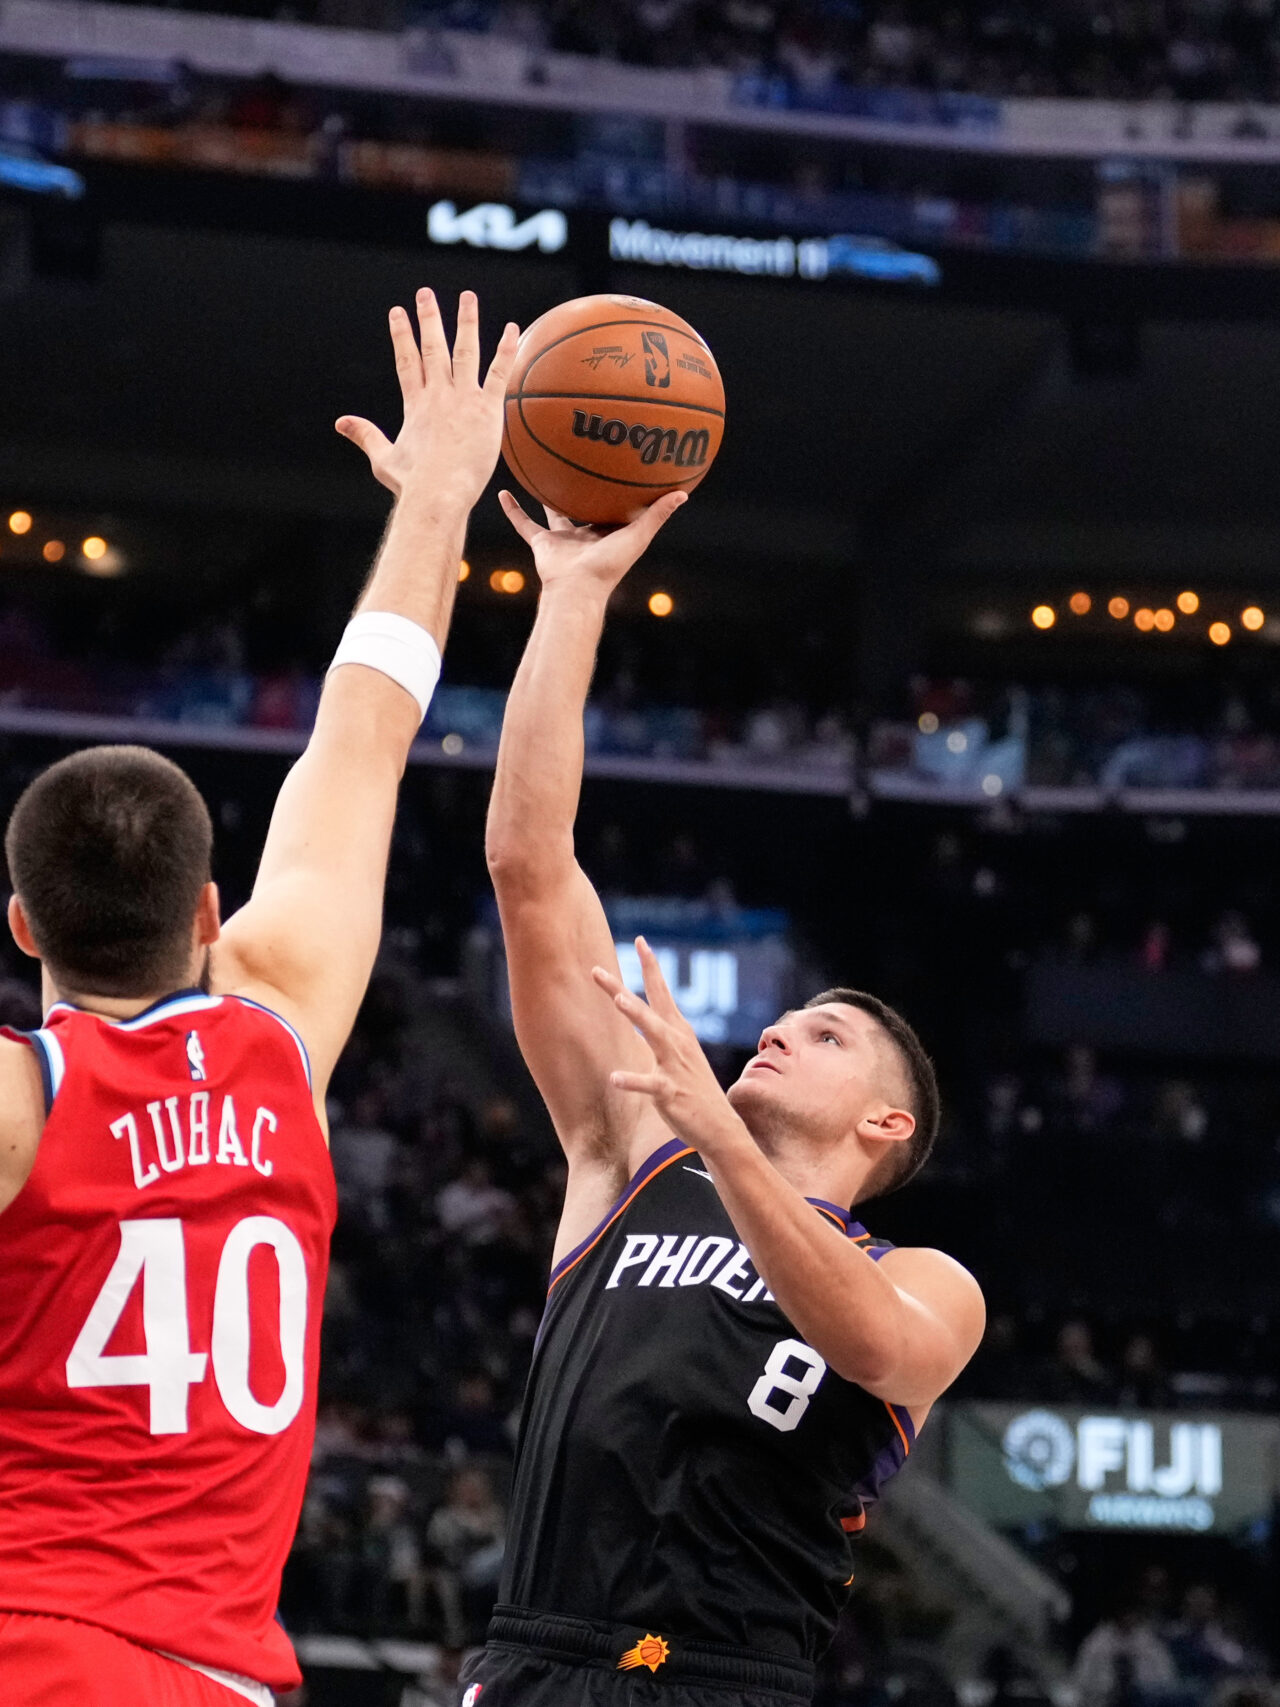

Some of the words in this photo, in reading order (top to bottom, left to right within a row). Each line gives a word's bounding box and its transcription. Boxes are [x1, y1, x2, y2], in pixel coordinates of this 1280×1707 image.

[609, 217, 795, 278] Movement
[572, 408, 710, 466] Wilson
[109, 1091, 277, 1189] ZUBAC
[66, 1215, 308, 1436] 40
[747, 1338, 827, 1432] 8
[1076, 1415, 1222, 1498] FIJI
